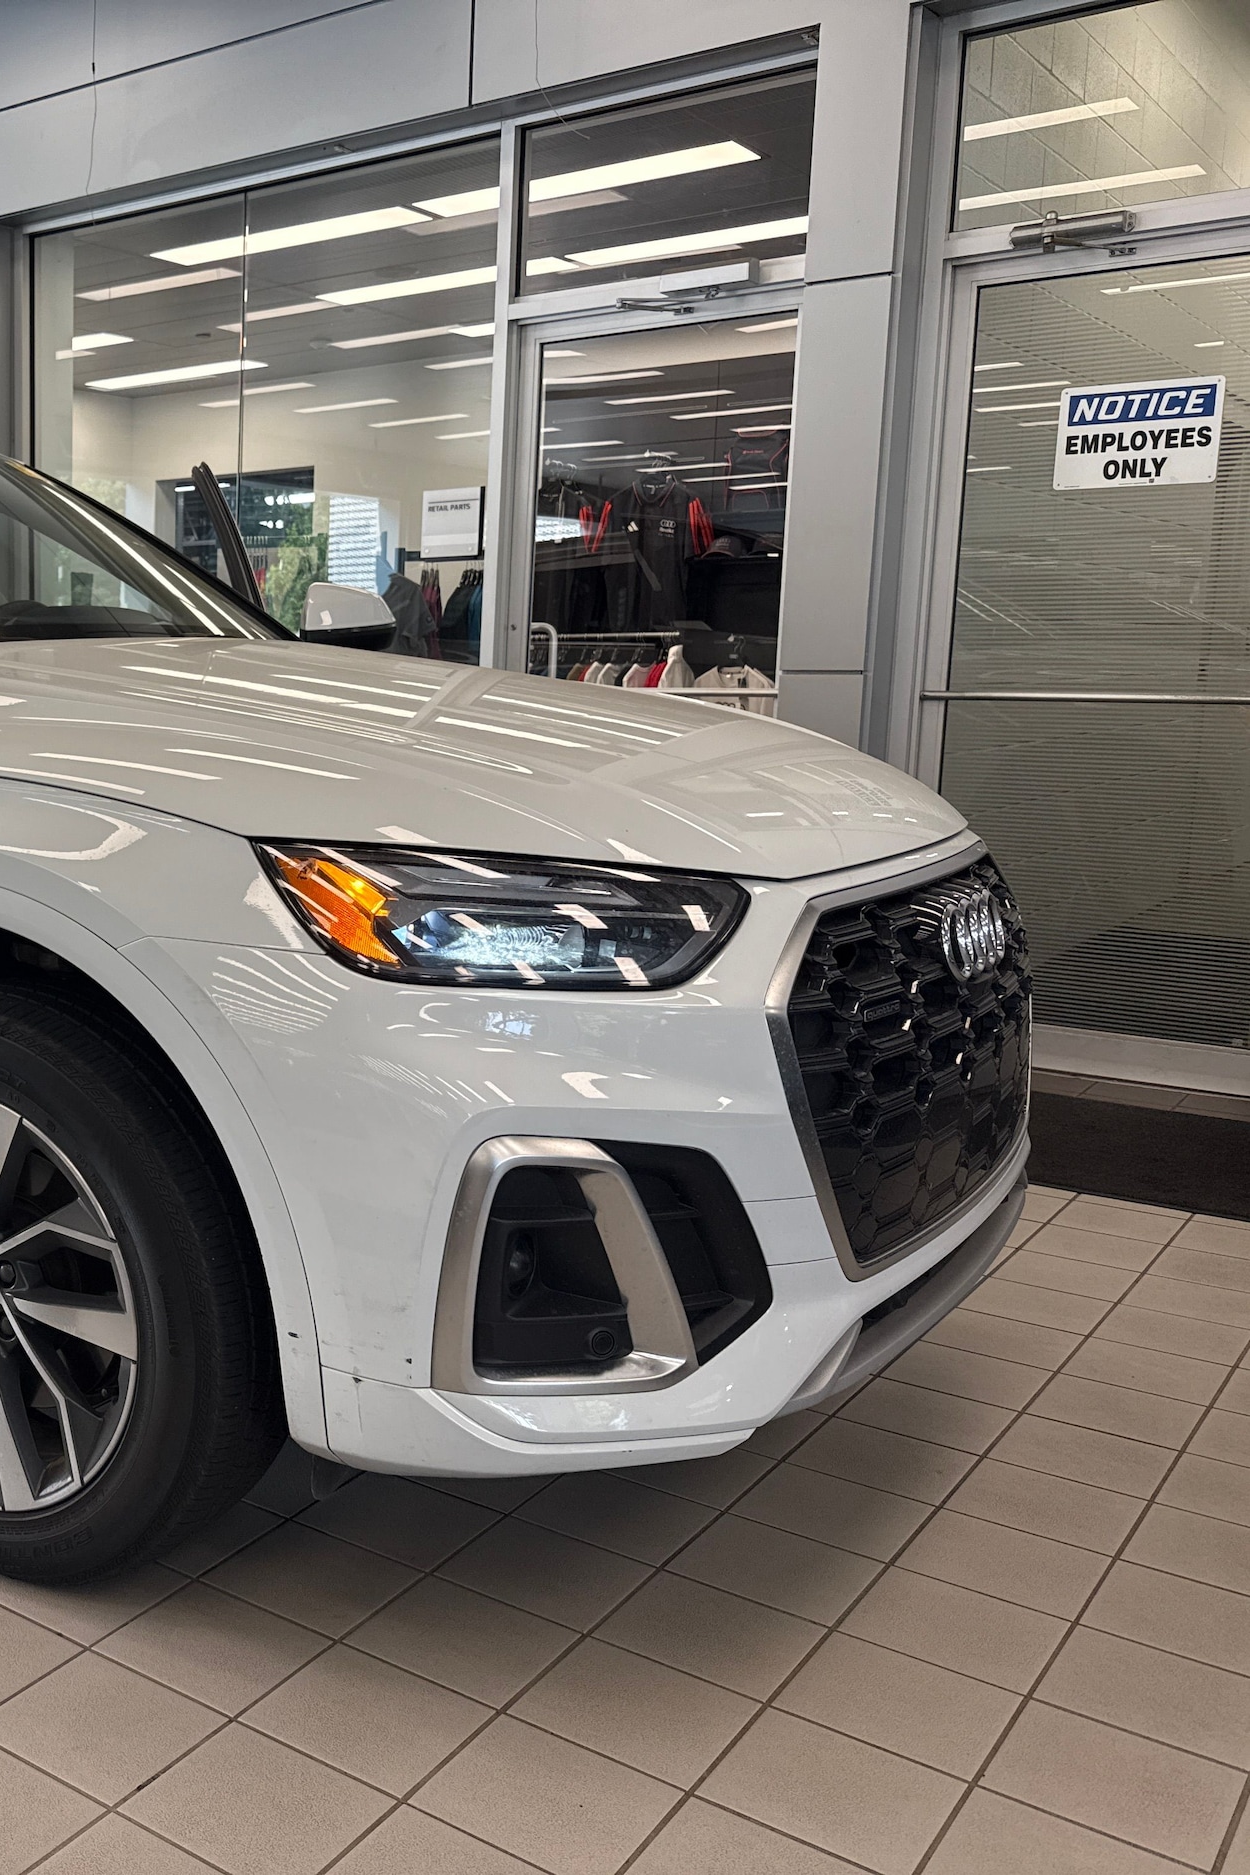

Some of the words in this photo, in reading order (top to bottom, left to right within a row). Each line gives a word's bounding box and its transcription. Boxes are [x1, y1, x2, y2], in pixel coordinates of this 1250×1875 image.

[1072, 388, 1211, 423] NOTICE
[1065, 426, 1212, 455] EMPLOYEES
[1103, 457, 1168, 480] ONLY
[428, 505, 449, 513] RETAIL
[450, 503, 471, 511] PARTS
